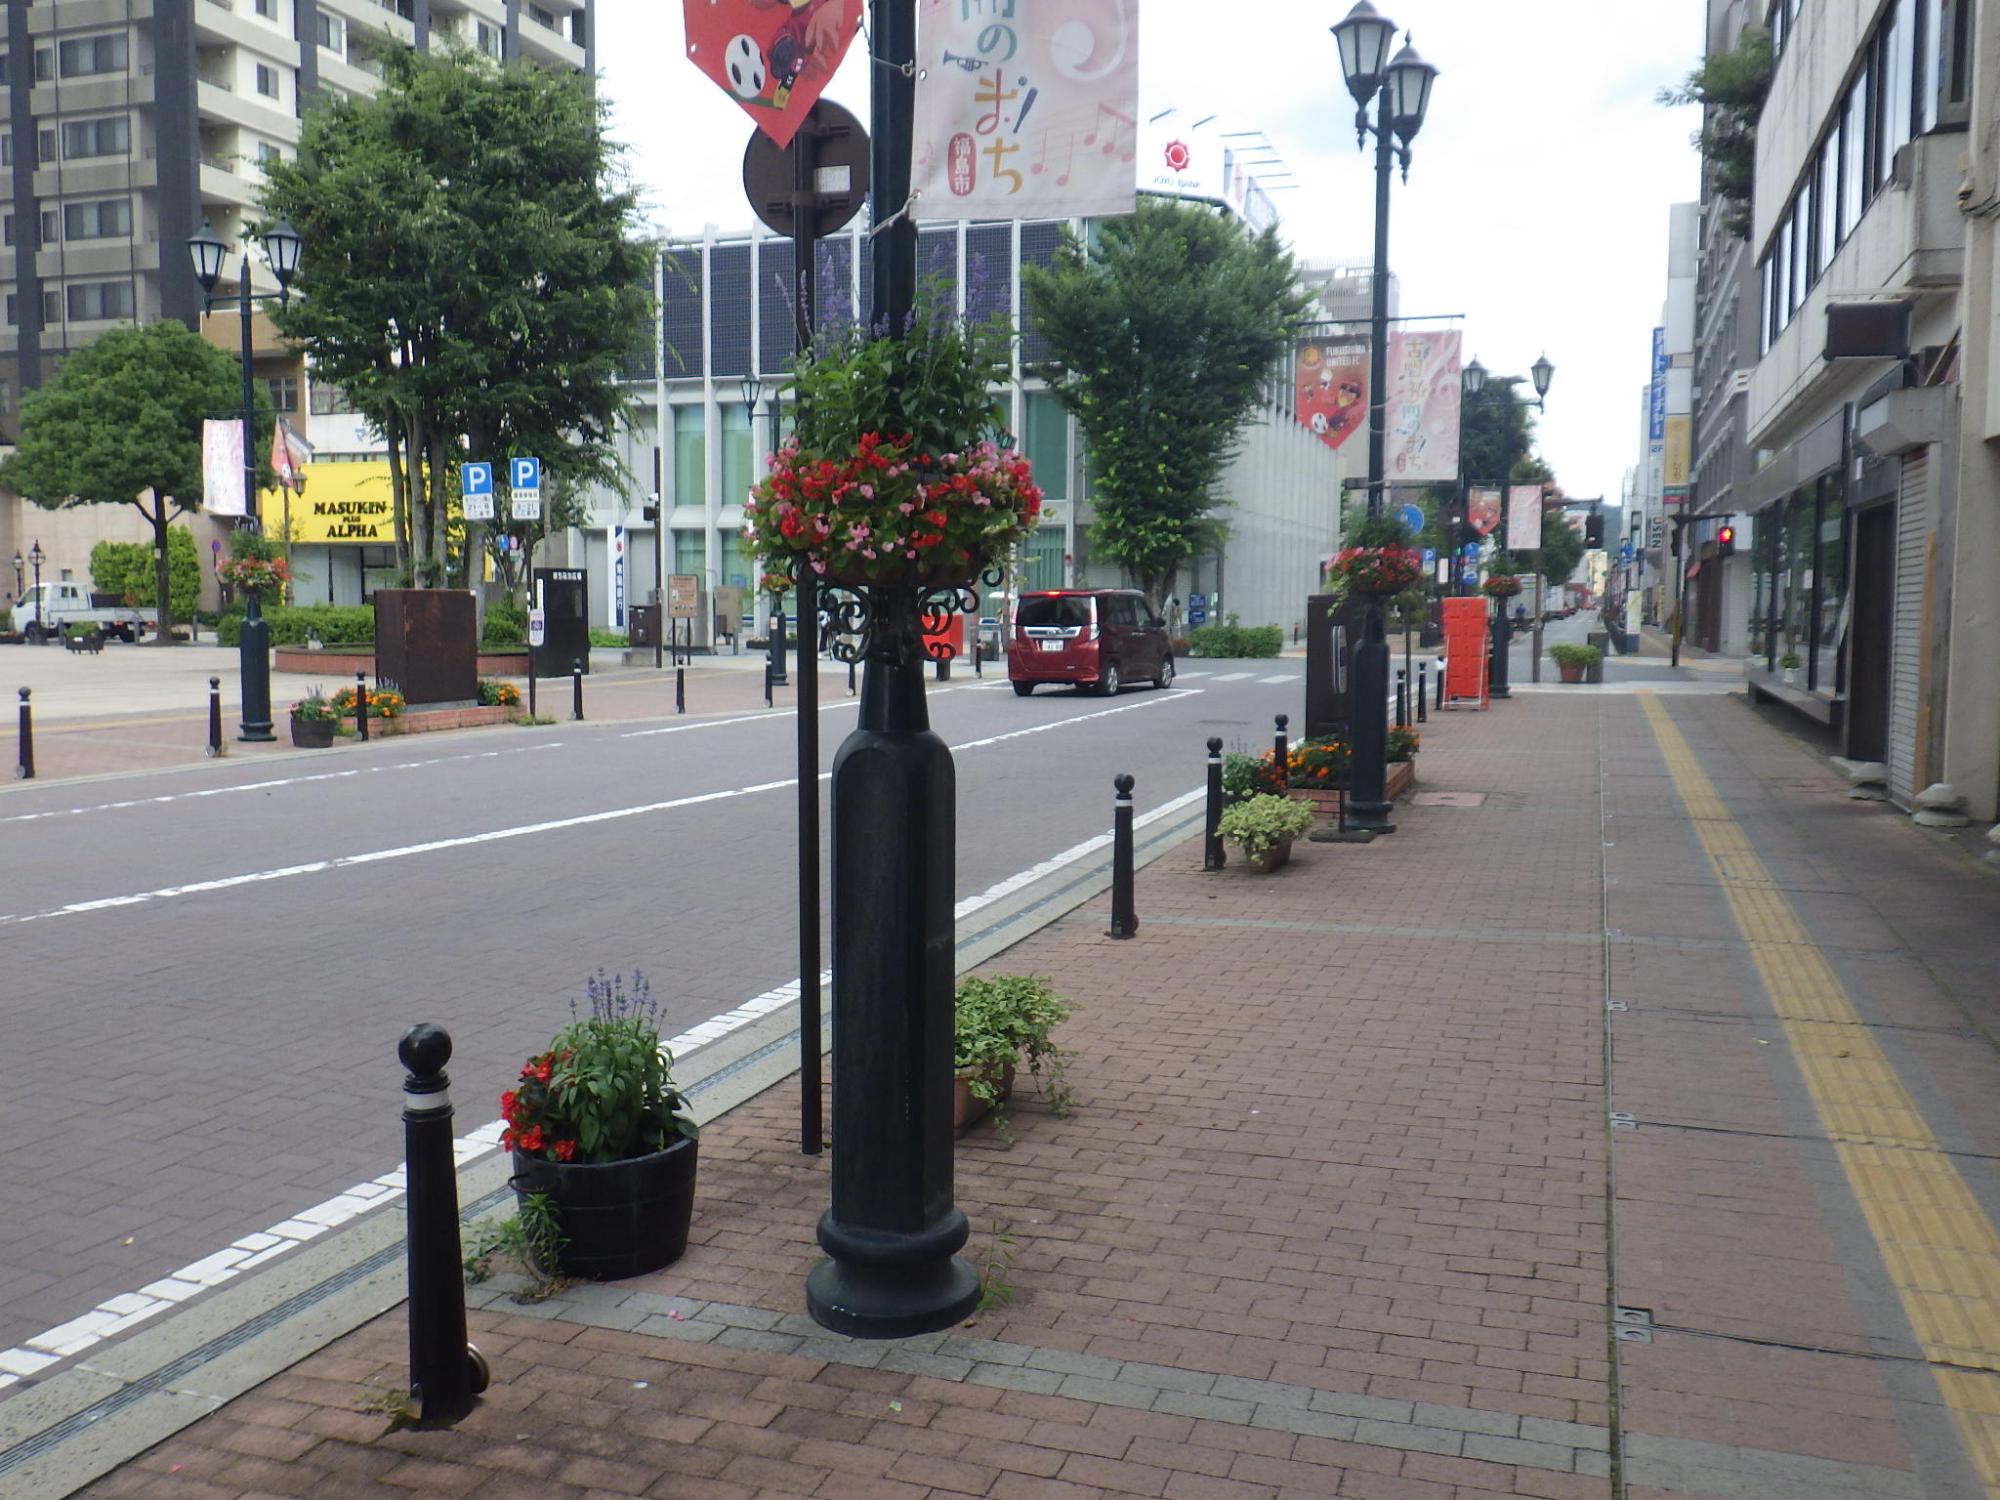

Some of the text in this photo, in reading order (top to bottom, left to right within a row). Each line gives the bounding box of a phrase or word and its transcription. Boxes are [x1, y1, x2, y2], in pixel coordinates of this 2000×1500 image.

[953, 136, 972, 194] 福島市
[1152, 176, 1175, 186] JOYO
[1326, 345, 1366, 356] FUKUSHIMA
[1326, 356, 1351, 367] UNITED
[469, 466, 486, 492] P
[518, 461, 534, 486] P
[314, 501, 386, 515] MASUKIN
[326, 525, 378, 538] ALPHA
[1652, 516, 1663, 549] USEN
